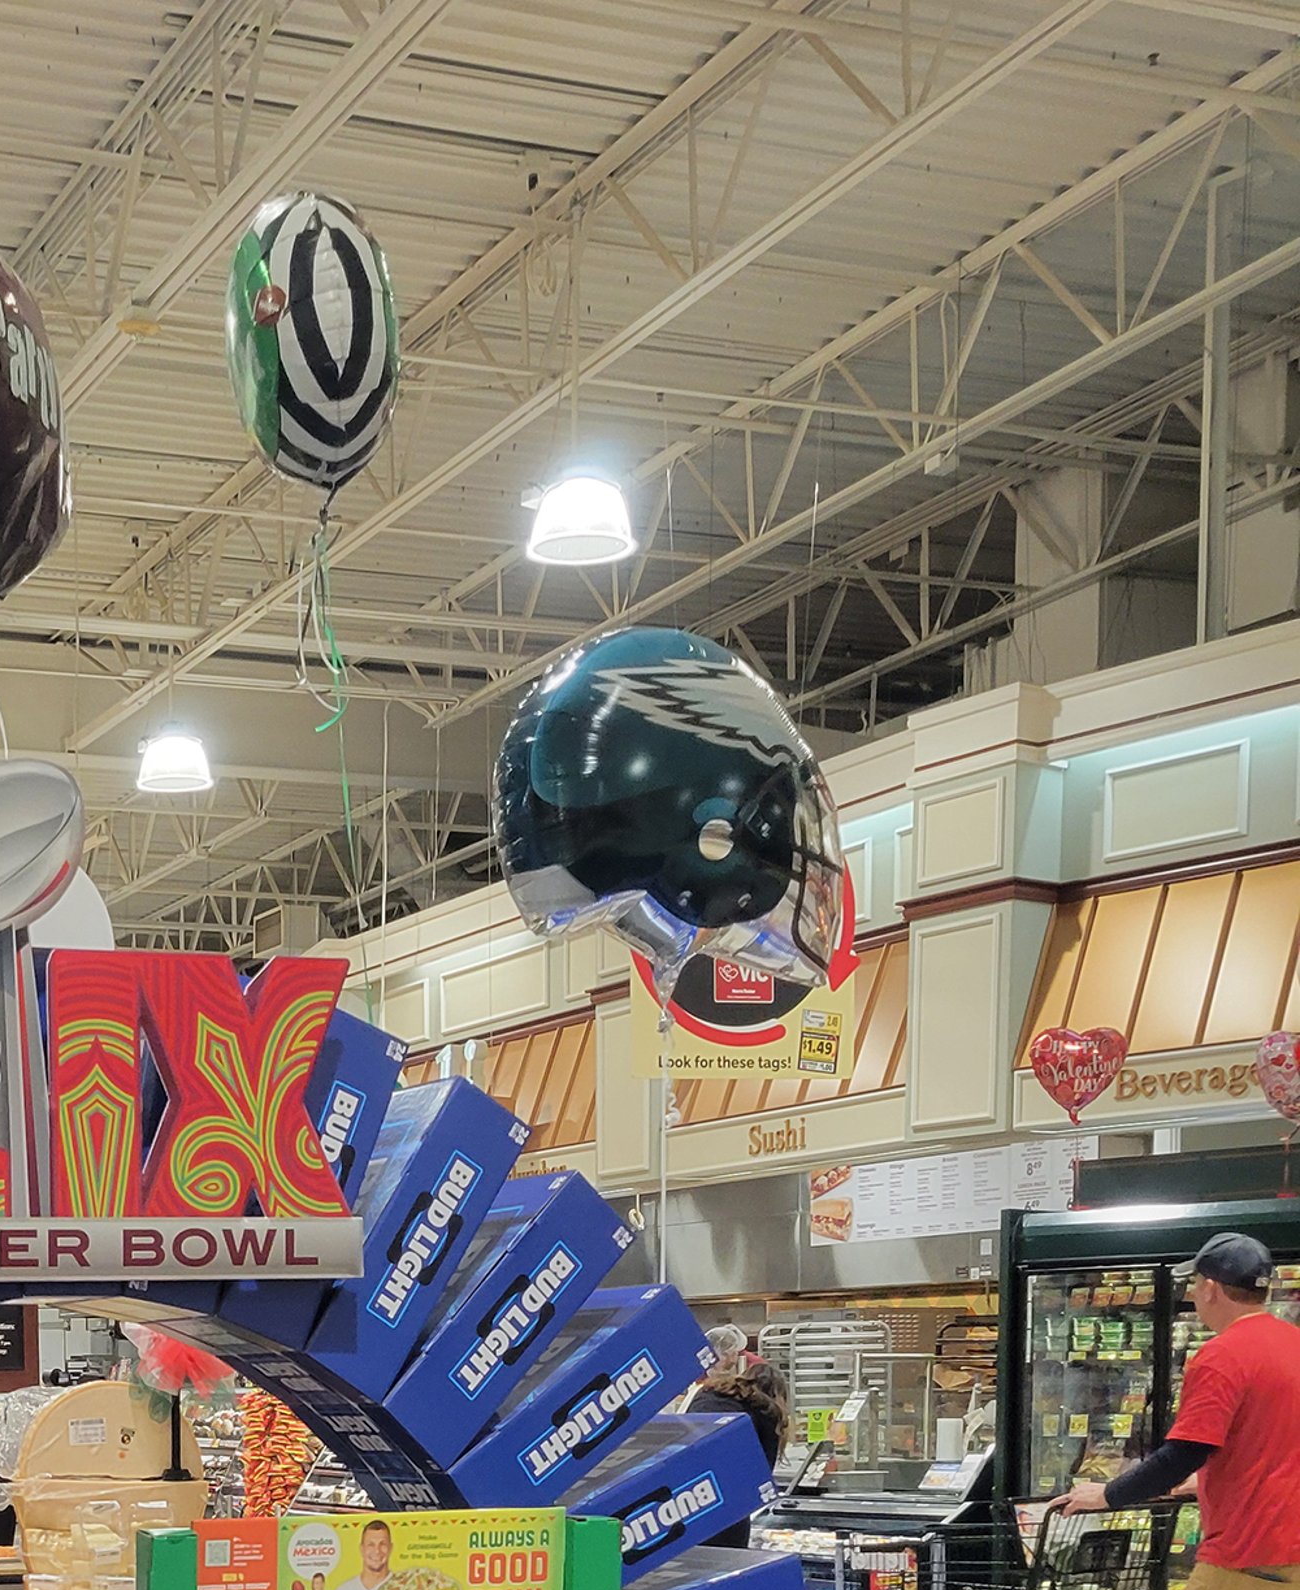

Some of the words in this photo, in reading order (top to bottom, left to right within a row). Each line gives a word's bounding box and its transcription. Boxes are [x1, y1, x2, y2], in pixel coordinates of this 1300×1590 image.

[694, 1055, 714, 1069] for
[716, 1055, 755, 1069] these
[758, 1056, 792, 1072] tags!
[803, 1041, 834, 1055] $1.49
[748, 1117, 807, 1156] Sushi
[122, 1227, 319, 1268] BOWL
[527, 1251, 575, 1314] BUD
[458, 1303, 530, 1391] LIGHT
[601, 1358, 656, 1415] BUD
[526, 1405, 605, 1477] LIGHT
[469, 1530, 534, 1548] ALWAYS
[540, 1529, 550, 1545] A
[468, 1551, 549, 1585] GOOD
